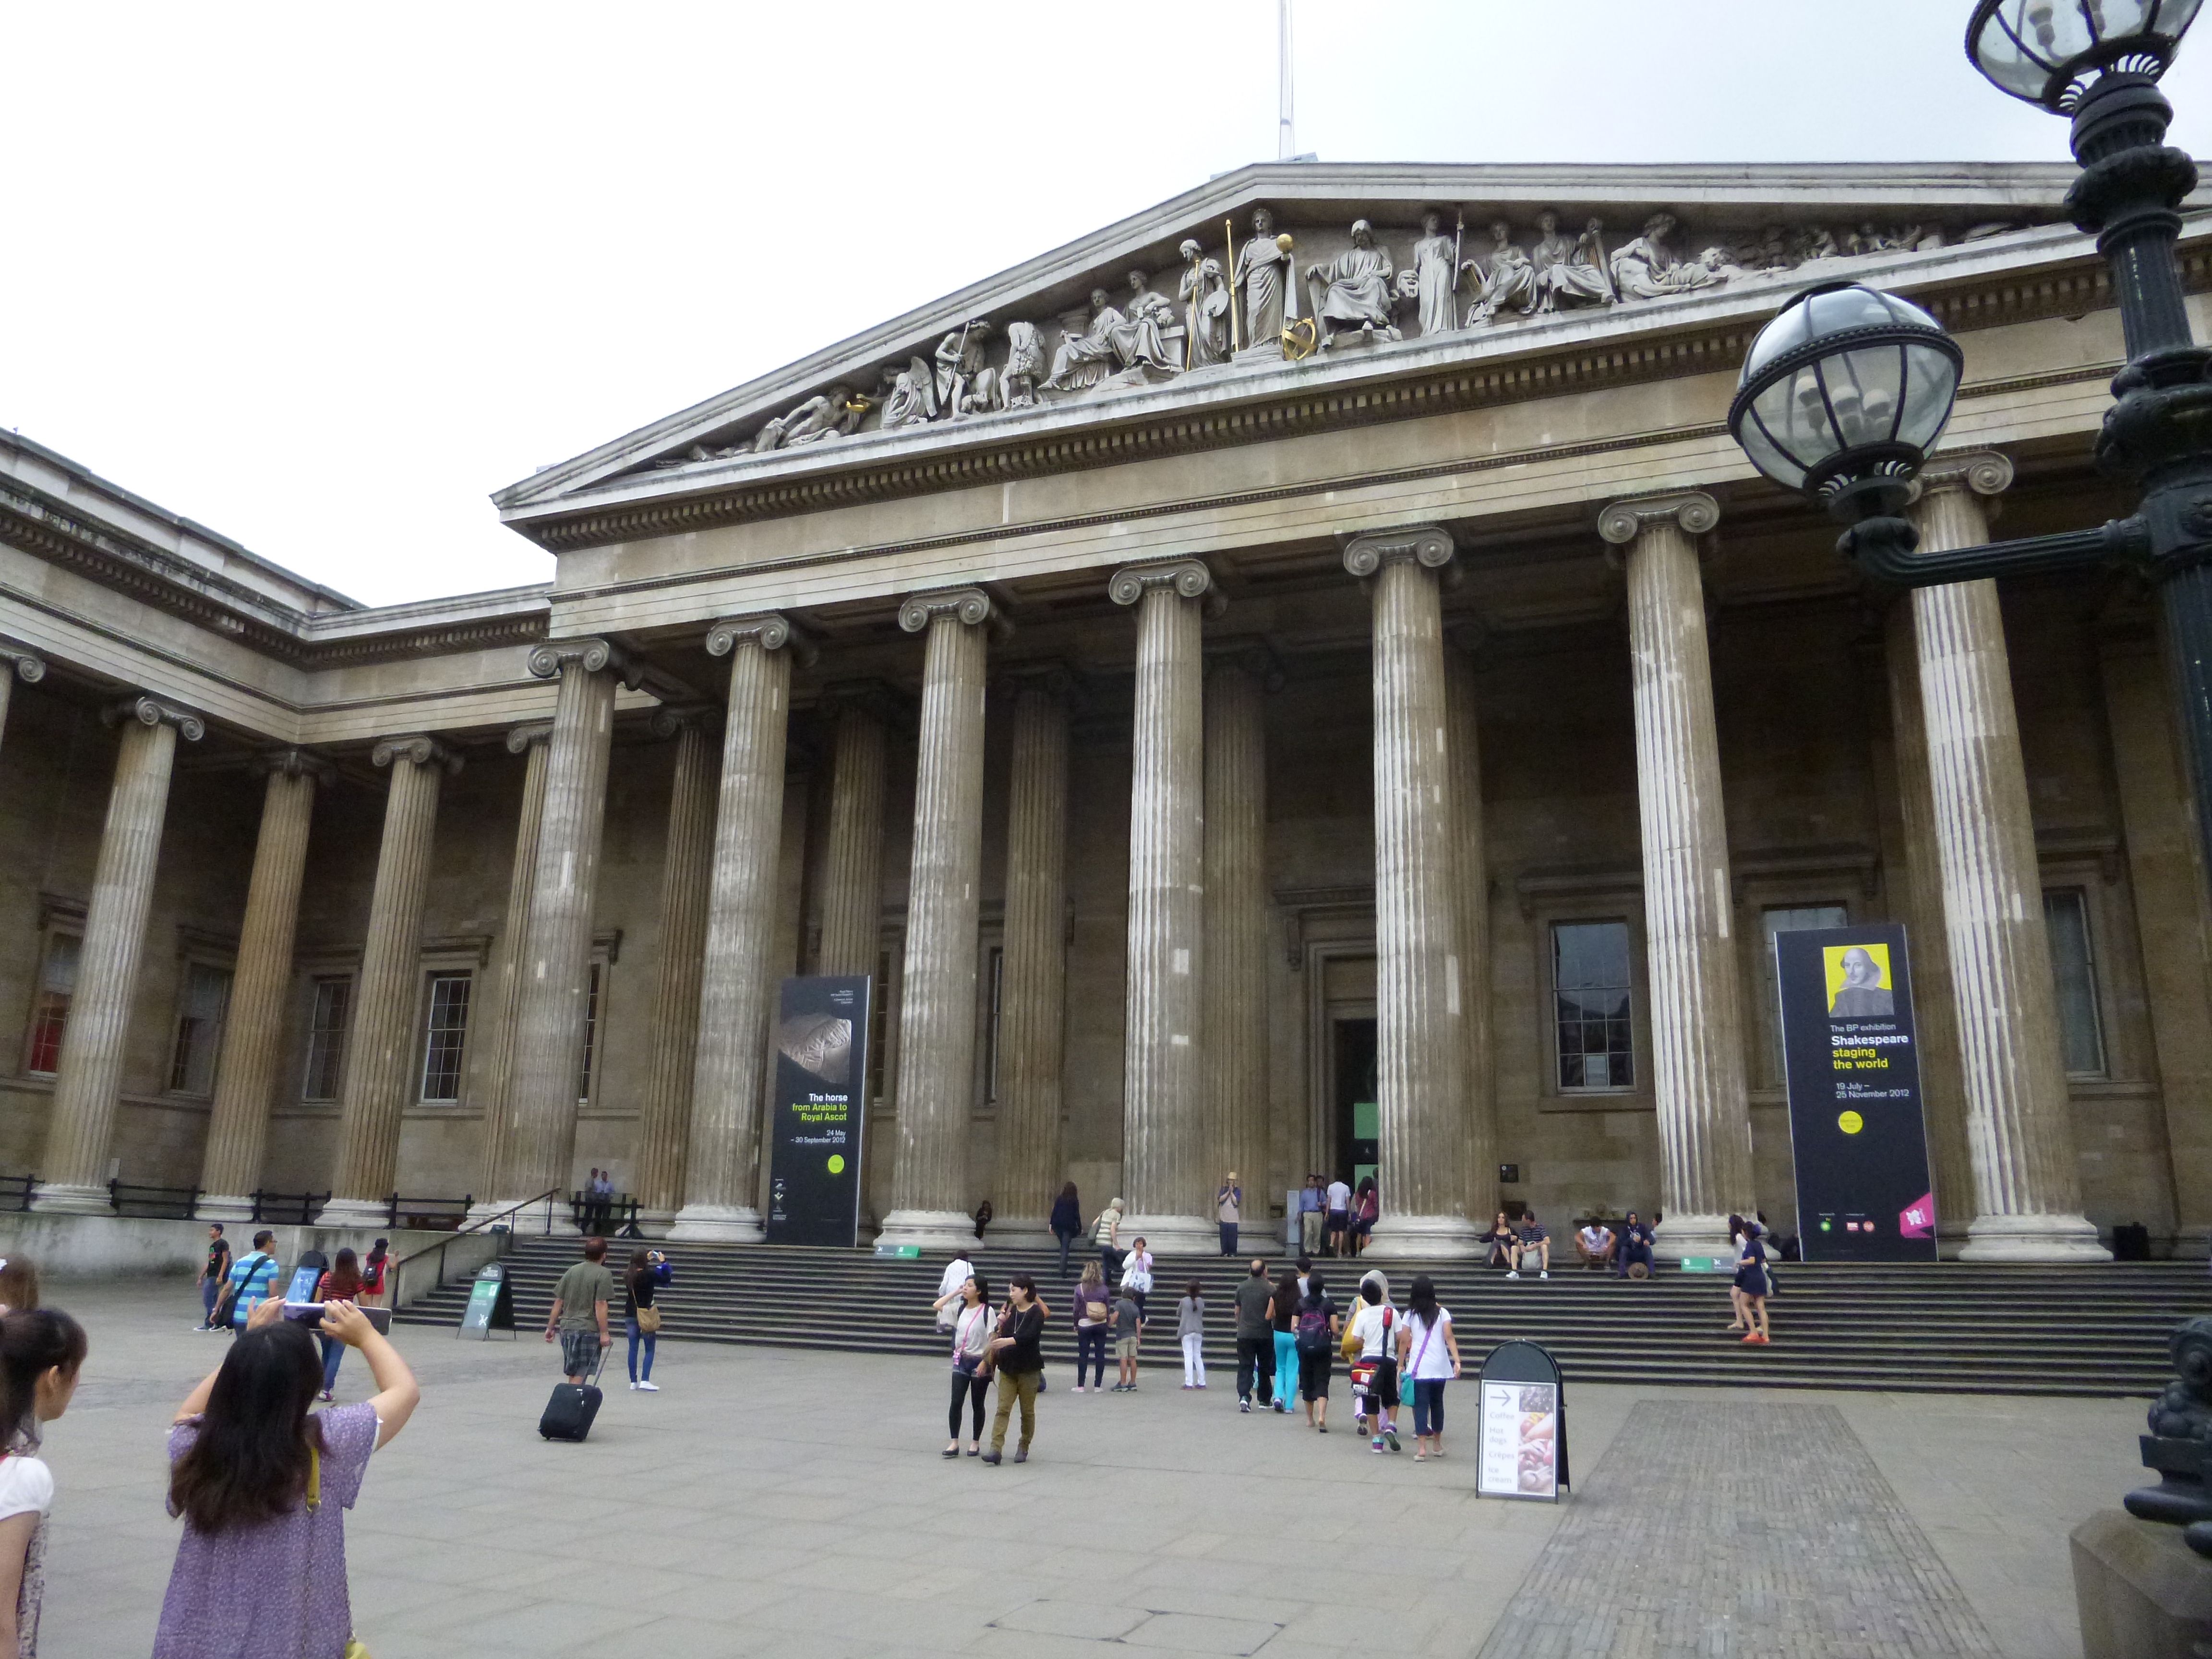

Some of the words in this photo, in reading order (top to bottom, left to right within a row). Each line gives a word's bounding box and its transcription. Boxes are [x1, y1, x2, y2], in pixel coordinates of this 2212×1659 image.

[1831, 1035, 1909, 1046] Shakespeare
[1833, 1047, 1876, 1058] staging
[1833, 1059, 1852, 1069] the
[1855, 1058, 1888, 1068] world
[1847, 1082, 1863, 1091] July
[809, 1093, 823, 1101] The
[826, 1093, 848, 1101] horse
[801, 1113, 822, 1122] Royal
[1490, 1412, 1515, 1420] Coffee
[1489, 1436, 1507, 1445] dogs
